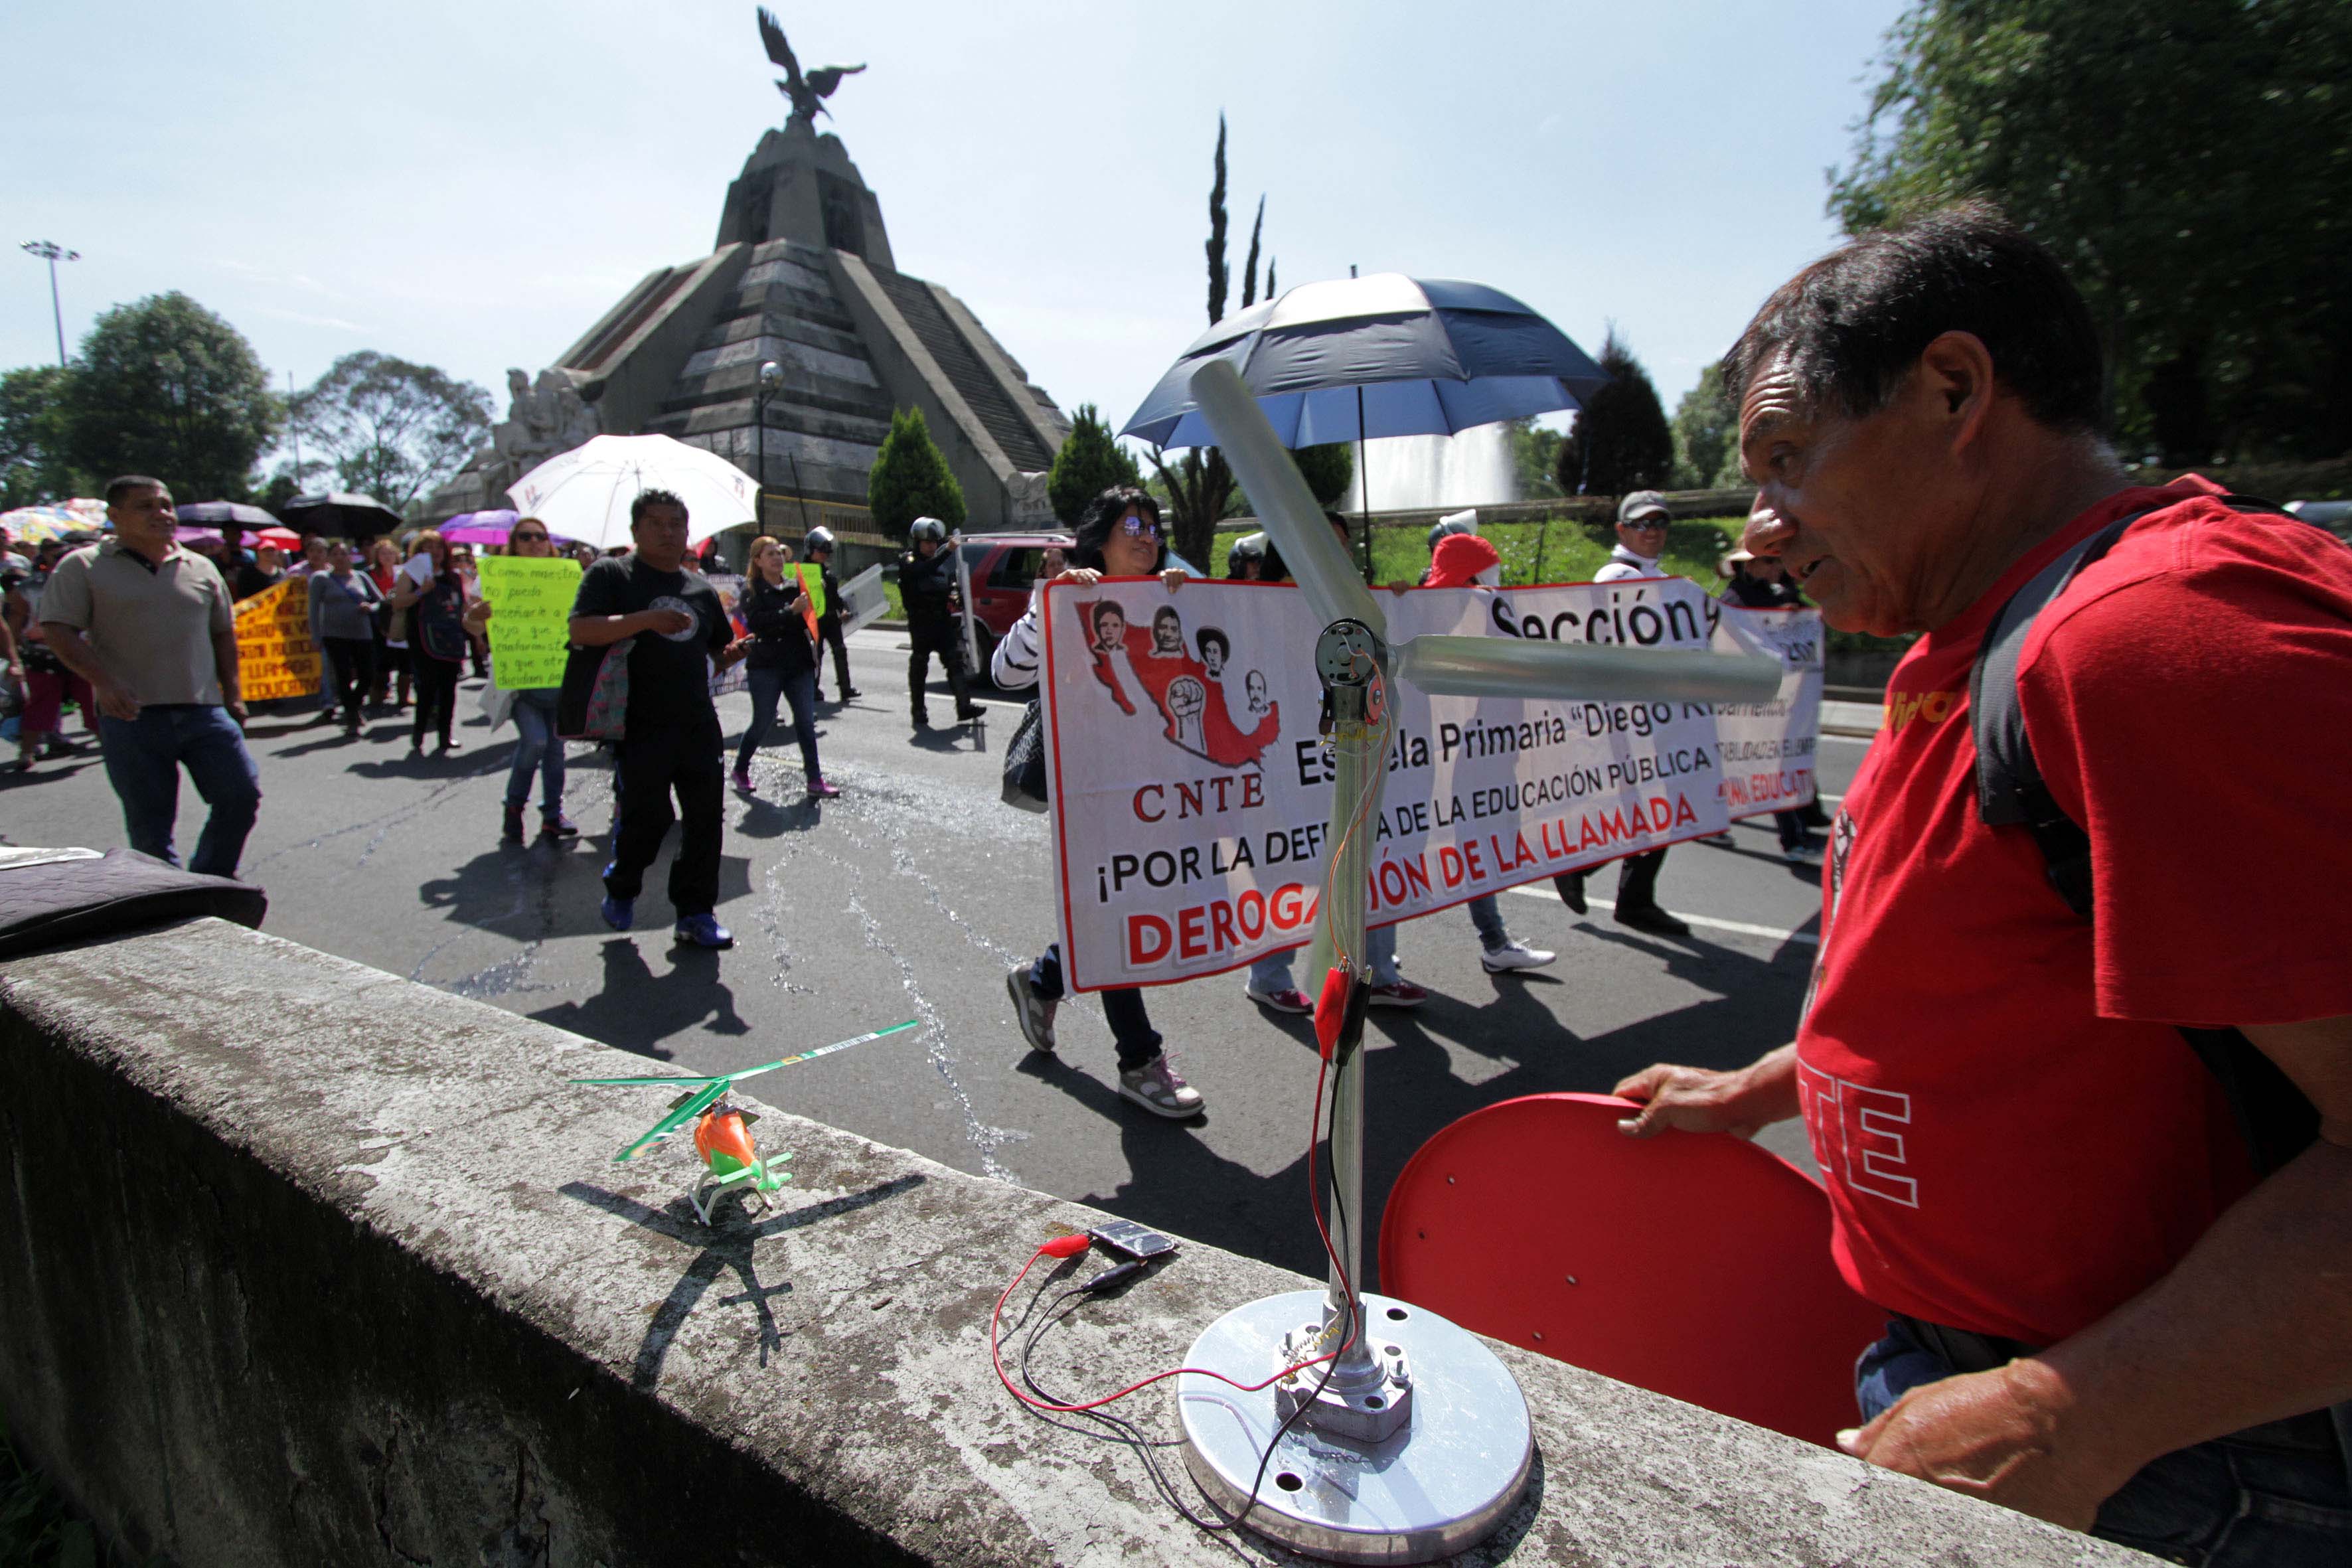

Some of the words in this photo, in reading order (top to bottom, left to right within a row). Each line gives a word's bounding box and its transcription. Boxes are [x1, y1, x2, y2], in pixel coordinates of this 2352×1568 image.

[483, 558, 525, 578] Como
[1492, 590, 1699, 645] Sección
[1296, 728, 1429, 786] Esla
[1441, 708, 1567, 763] Primaria
[1097, 846, 1200, 903] ¡POR
[1211, 836, 1255, 876] LA
[1265, 811, 1393, 866] DEFA
[1396, 801, 1430, 834] DE
[1435, 796, 1465, 828] LA
[1472, 763, 1605, 819] EDUCACIÓN
[1608, 745, 1712, 789] PÚBLICA
[1133, 773, 1265, 823] CNTE
[1129, 846, 1432, 965] DEROGIÓN
[1439, 838, 1487, 890] DE
[1491, 830, 1538, 873] LA
[1540, 792, 1699, 860] LLAMADA
